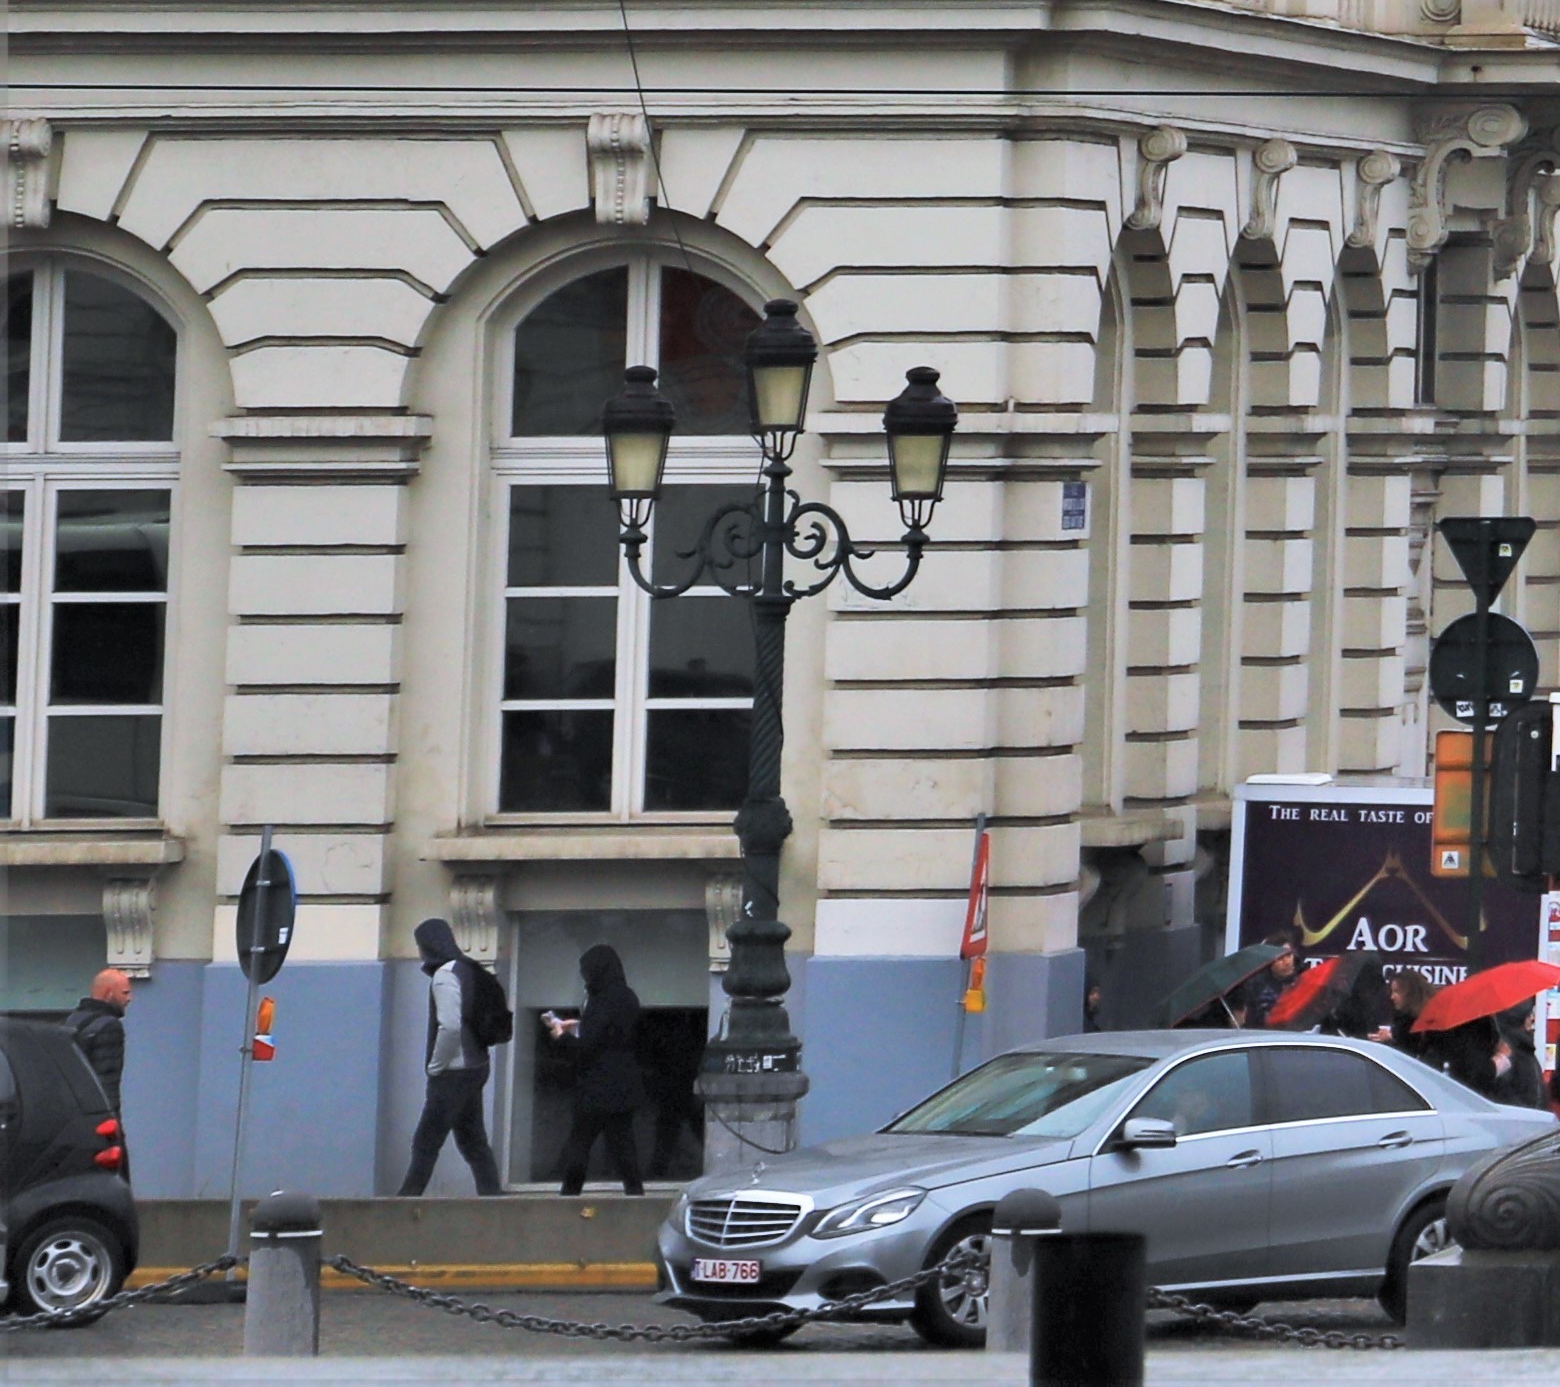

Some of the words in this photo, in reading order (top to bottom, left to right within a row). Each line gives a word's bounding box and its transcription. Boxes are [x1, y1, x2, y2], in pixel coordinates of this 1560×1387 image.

[1269, 804, 1300, 821] THE
[1309, 808, 1349, 822] REAL
[1358, 809, 1405, 823] TASTE
[1413, 810, 1434, 824] OF
[1346, 916, 1430, 953] AOR
